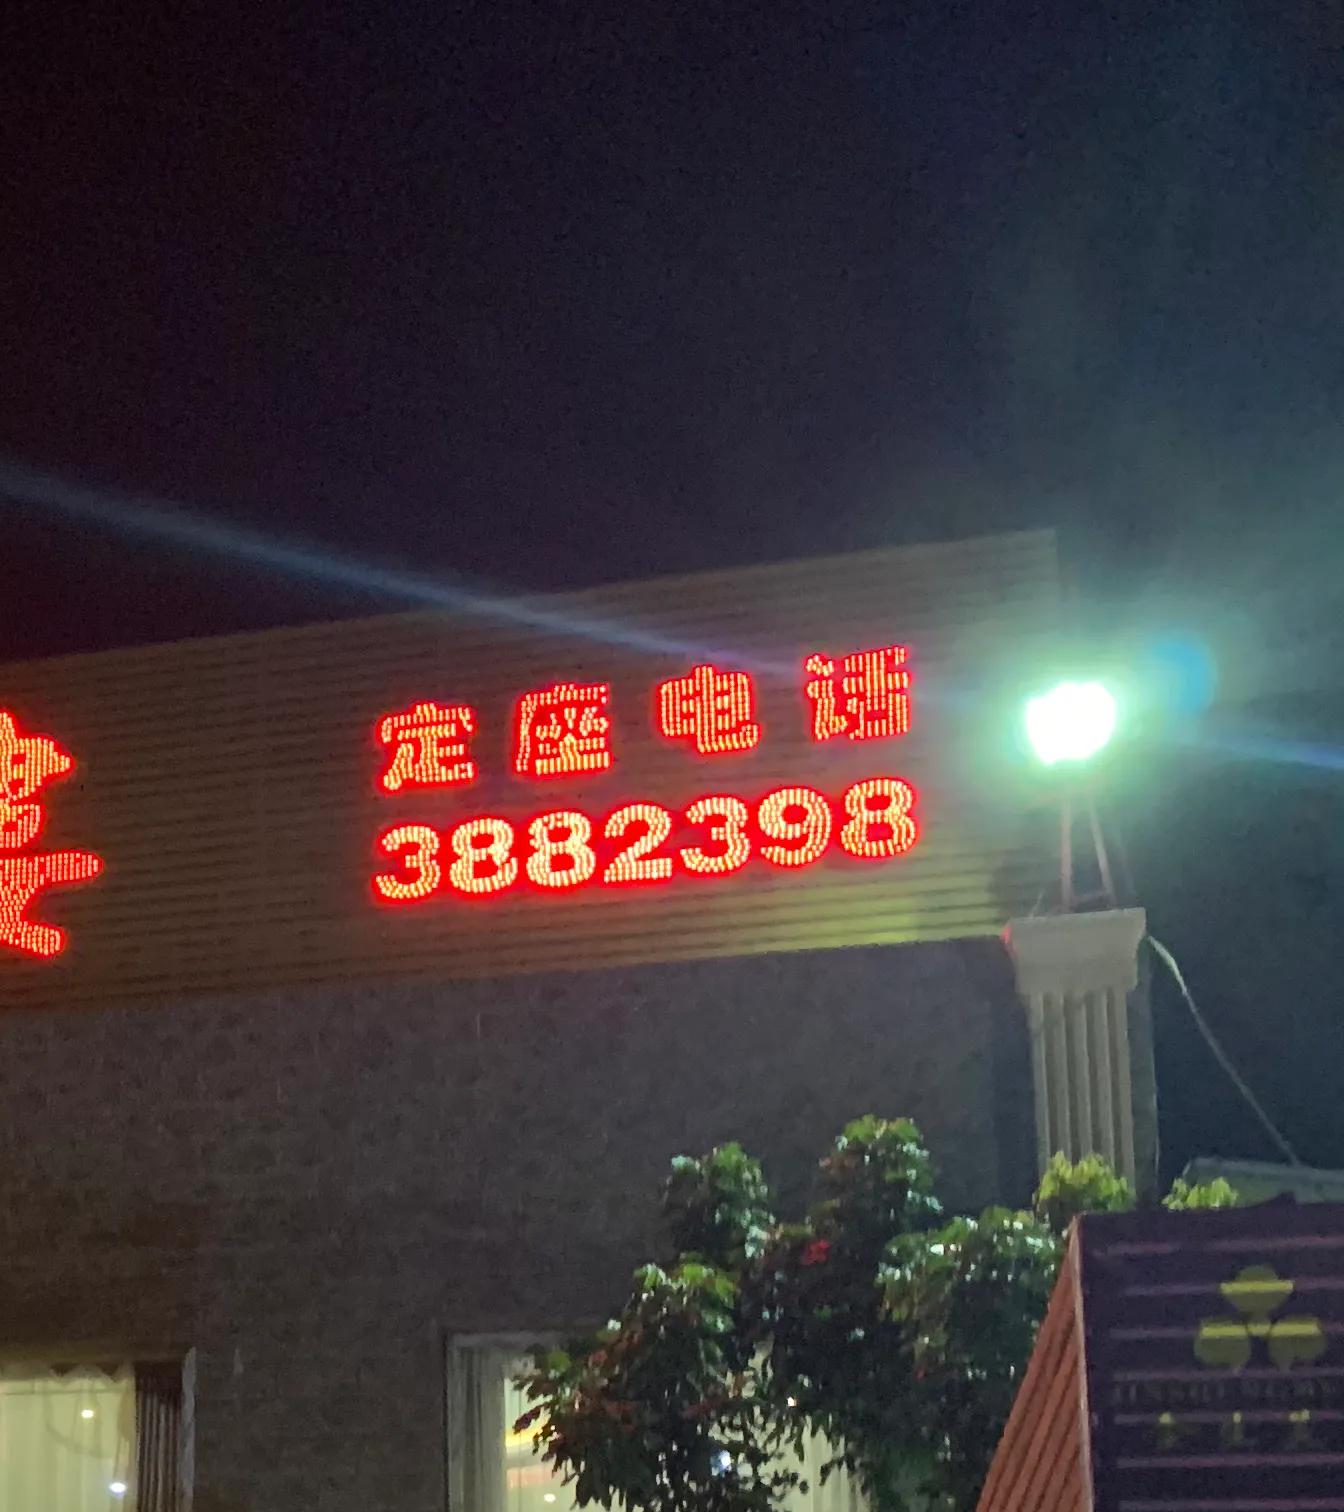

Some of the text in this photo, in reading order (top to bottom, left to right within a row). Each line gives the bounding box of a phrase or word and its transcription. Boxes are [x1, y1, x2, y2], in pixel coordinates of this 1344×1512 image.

[377, 646, 912, 792] 定座电话
[374, 775, 919, 902] 3882398
